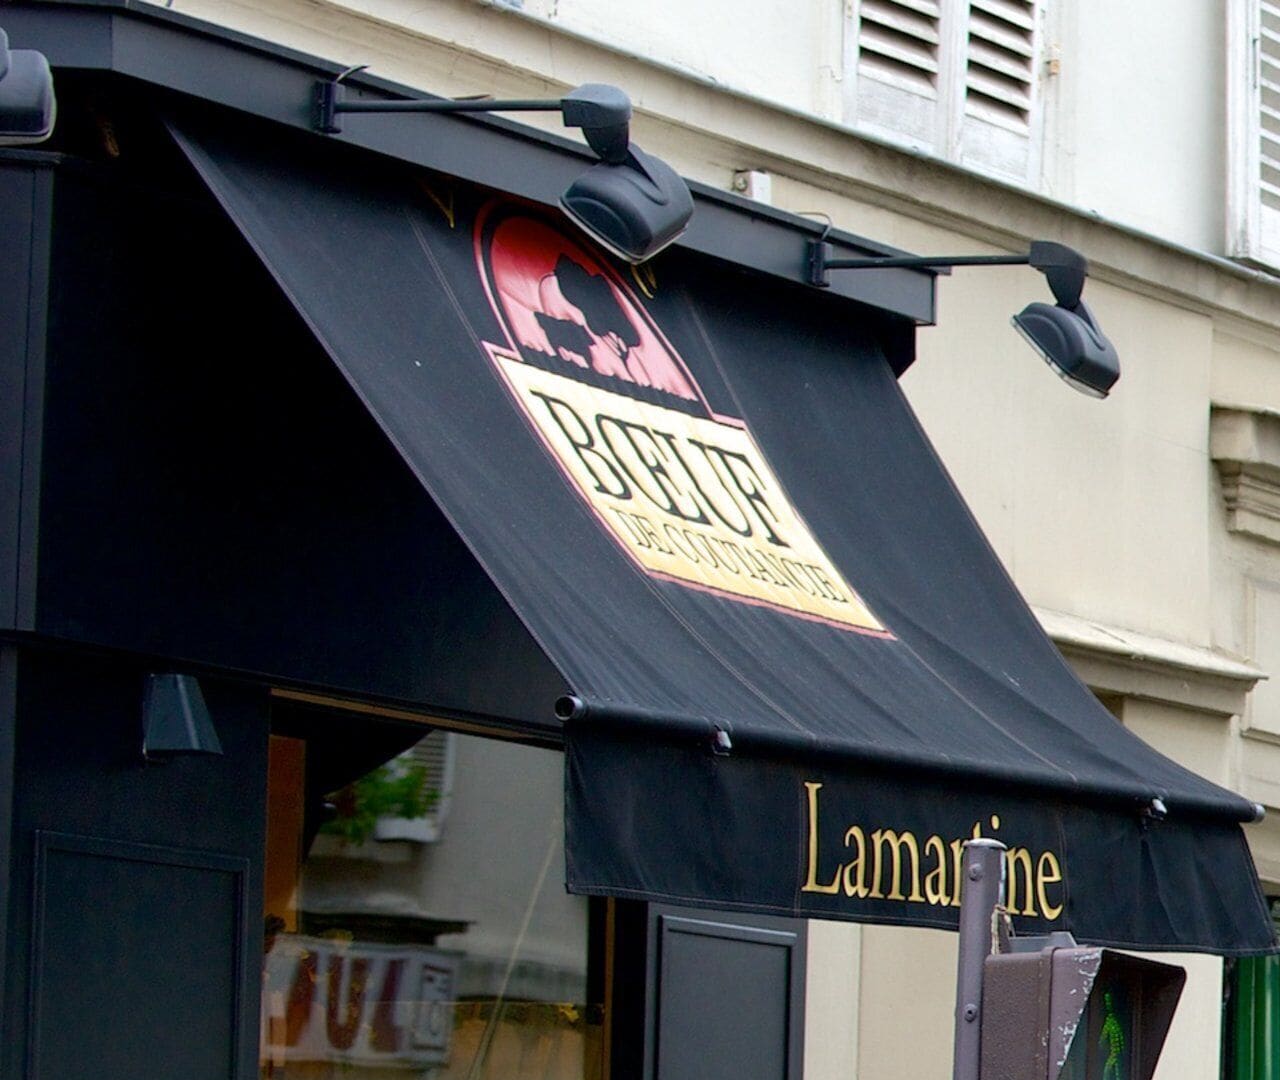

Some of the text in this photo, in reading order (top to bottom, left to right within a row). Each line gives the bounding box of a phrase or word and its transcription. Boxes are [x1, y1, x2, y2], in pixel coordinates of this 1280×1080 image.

[609, 506, 849, 603] DE COUTANCIE
[801, 781, 1064, 920] Lamarne
